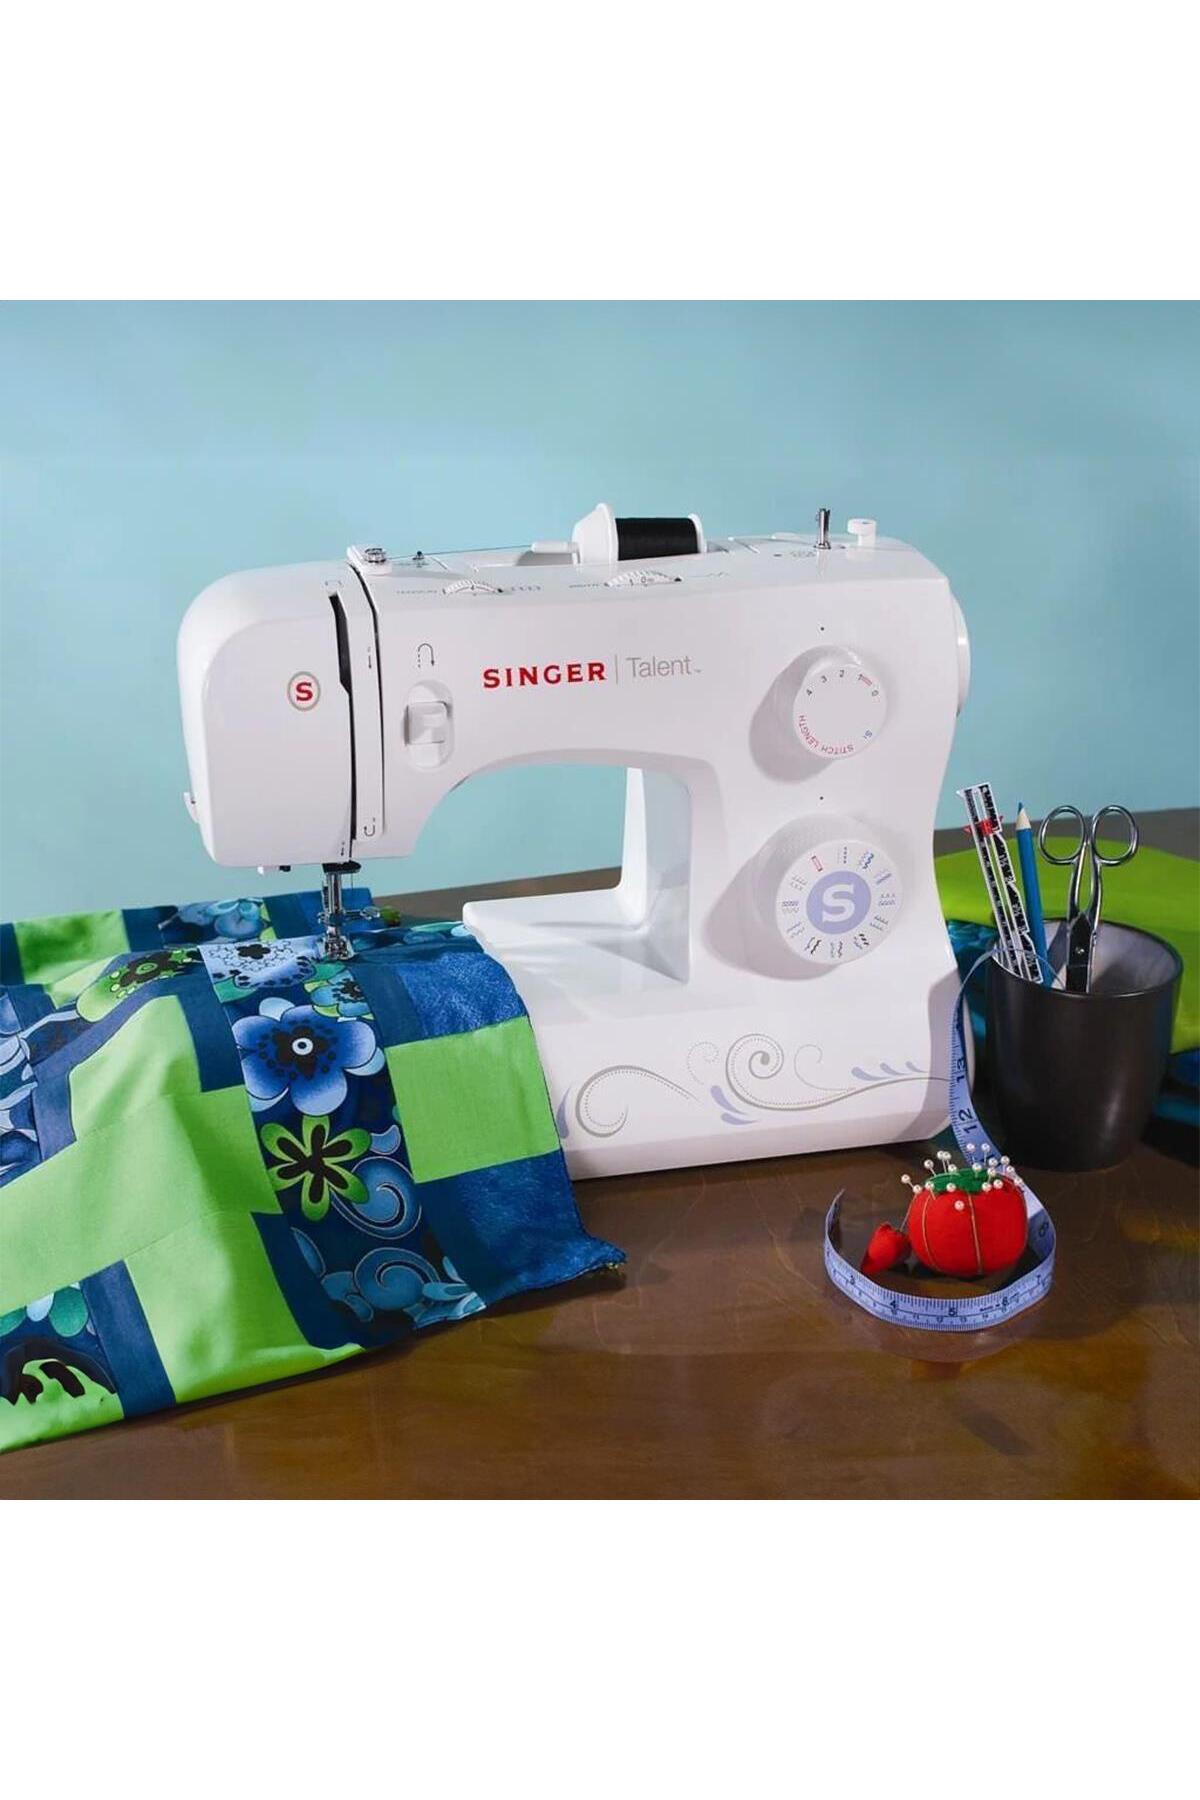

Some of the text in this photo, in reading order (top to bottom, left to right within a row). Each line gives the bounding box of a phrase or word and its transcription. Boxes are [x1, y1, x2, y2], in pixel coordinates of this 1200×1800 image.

[483, 655, 692, 688] SINGER Talent
[296, 682, 313, 701] S
[799, 715, 854, 755] STITCH LENGTH
[822, 884, 855, 923] S
[956, 1056, 966, 1083] 13
[959, 1108, 978, 1134] 12
[948, 1307, 958, 1317] 5
